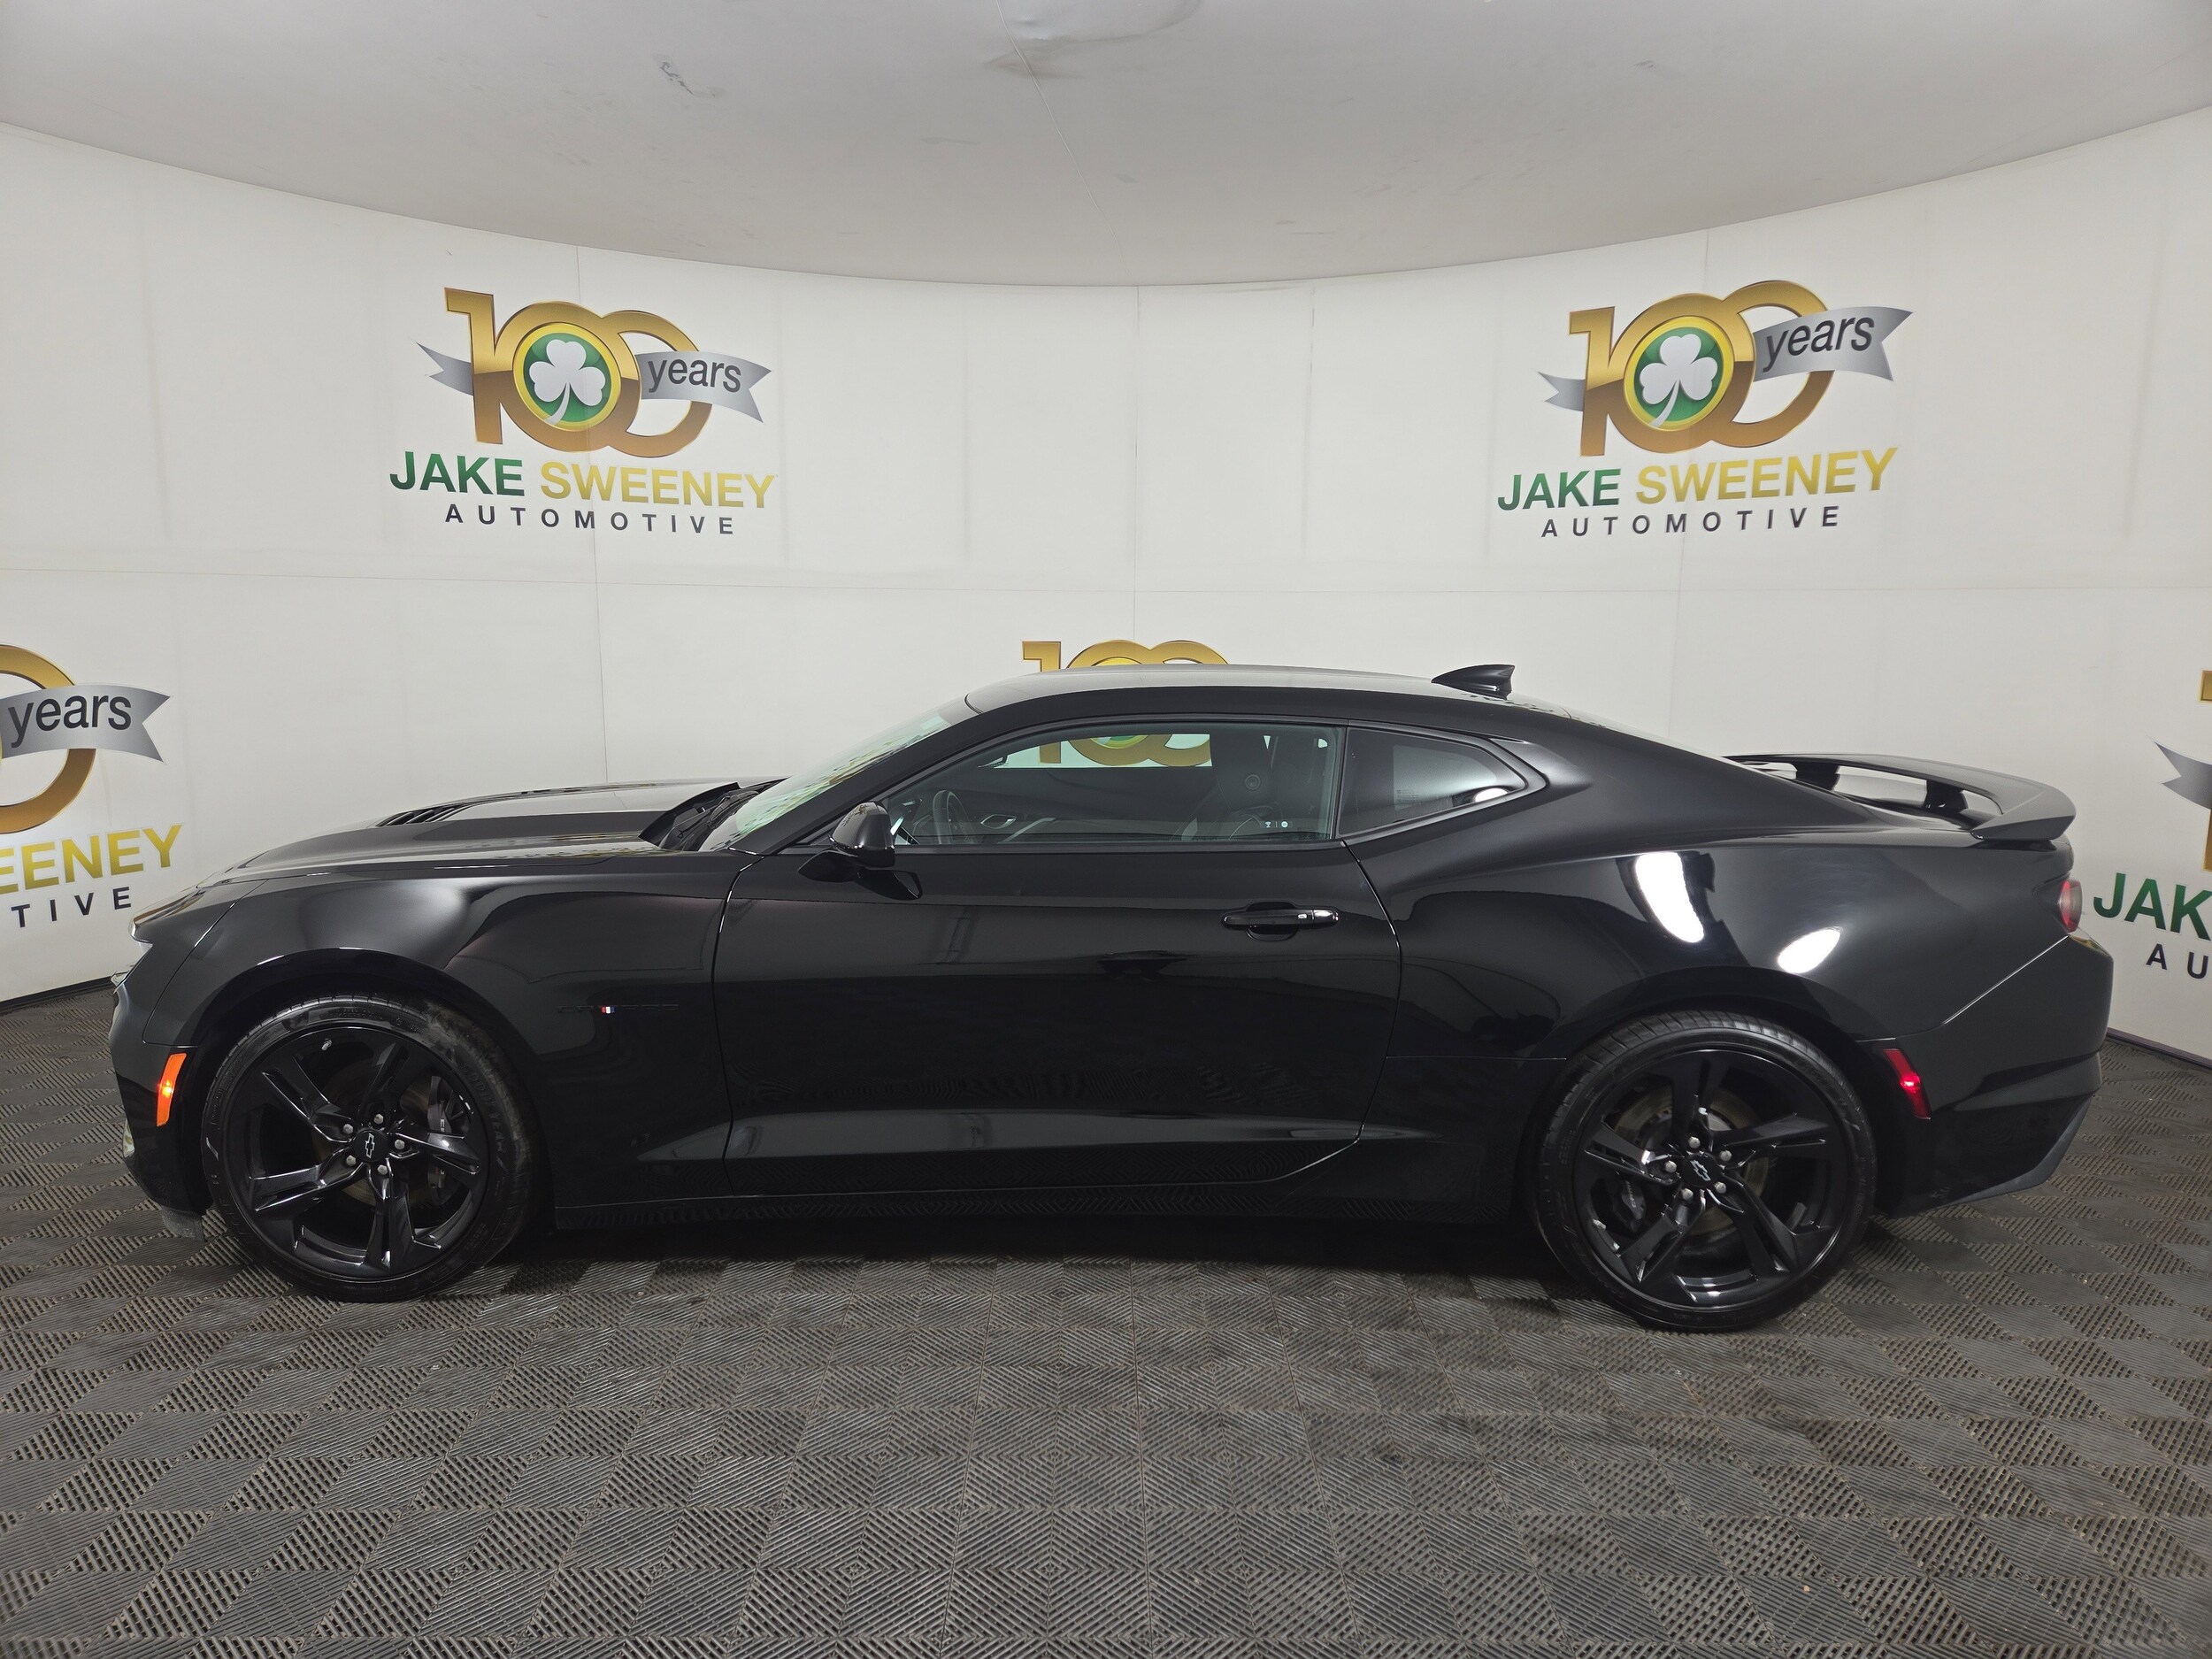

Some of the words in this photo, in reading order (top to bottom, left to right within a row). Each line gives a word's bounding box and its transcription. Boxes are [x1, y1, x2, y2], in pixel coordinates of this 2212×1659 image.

[443, 287, 713, 458] 100
[647, 358, 742, 394] years
[1569, 279, 1836, 457] 100
[1762, 316, 1876, 373] years
[389, 450, 526, 497] JAKE
[540, 461, 775, 509] SWEENEY
[1497, 468, 1622, 511] JAKE
[1635, 447, 1898, 505] SWEENEY
[445, 503, 733, 534] AUTOMOTIVE
[1540, 505, 1839, 538] AUTOMOTIVE
[8, 695, 132, 749] years
